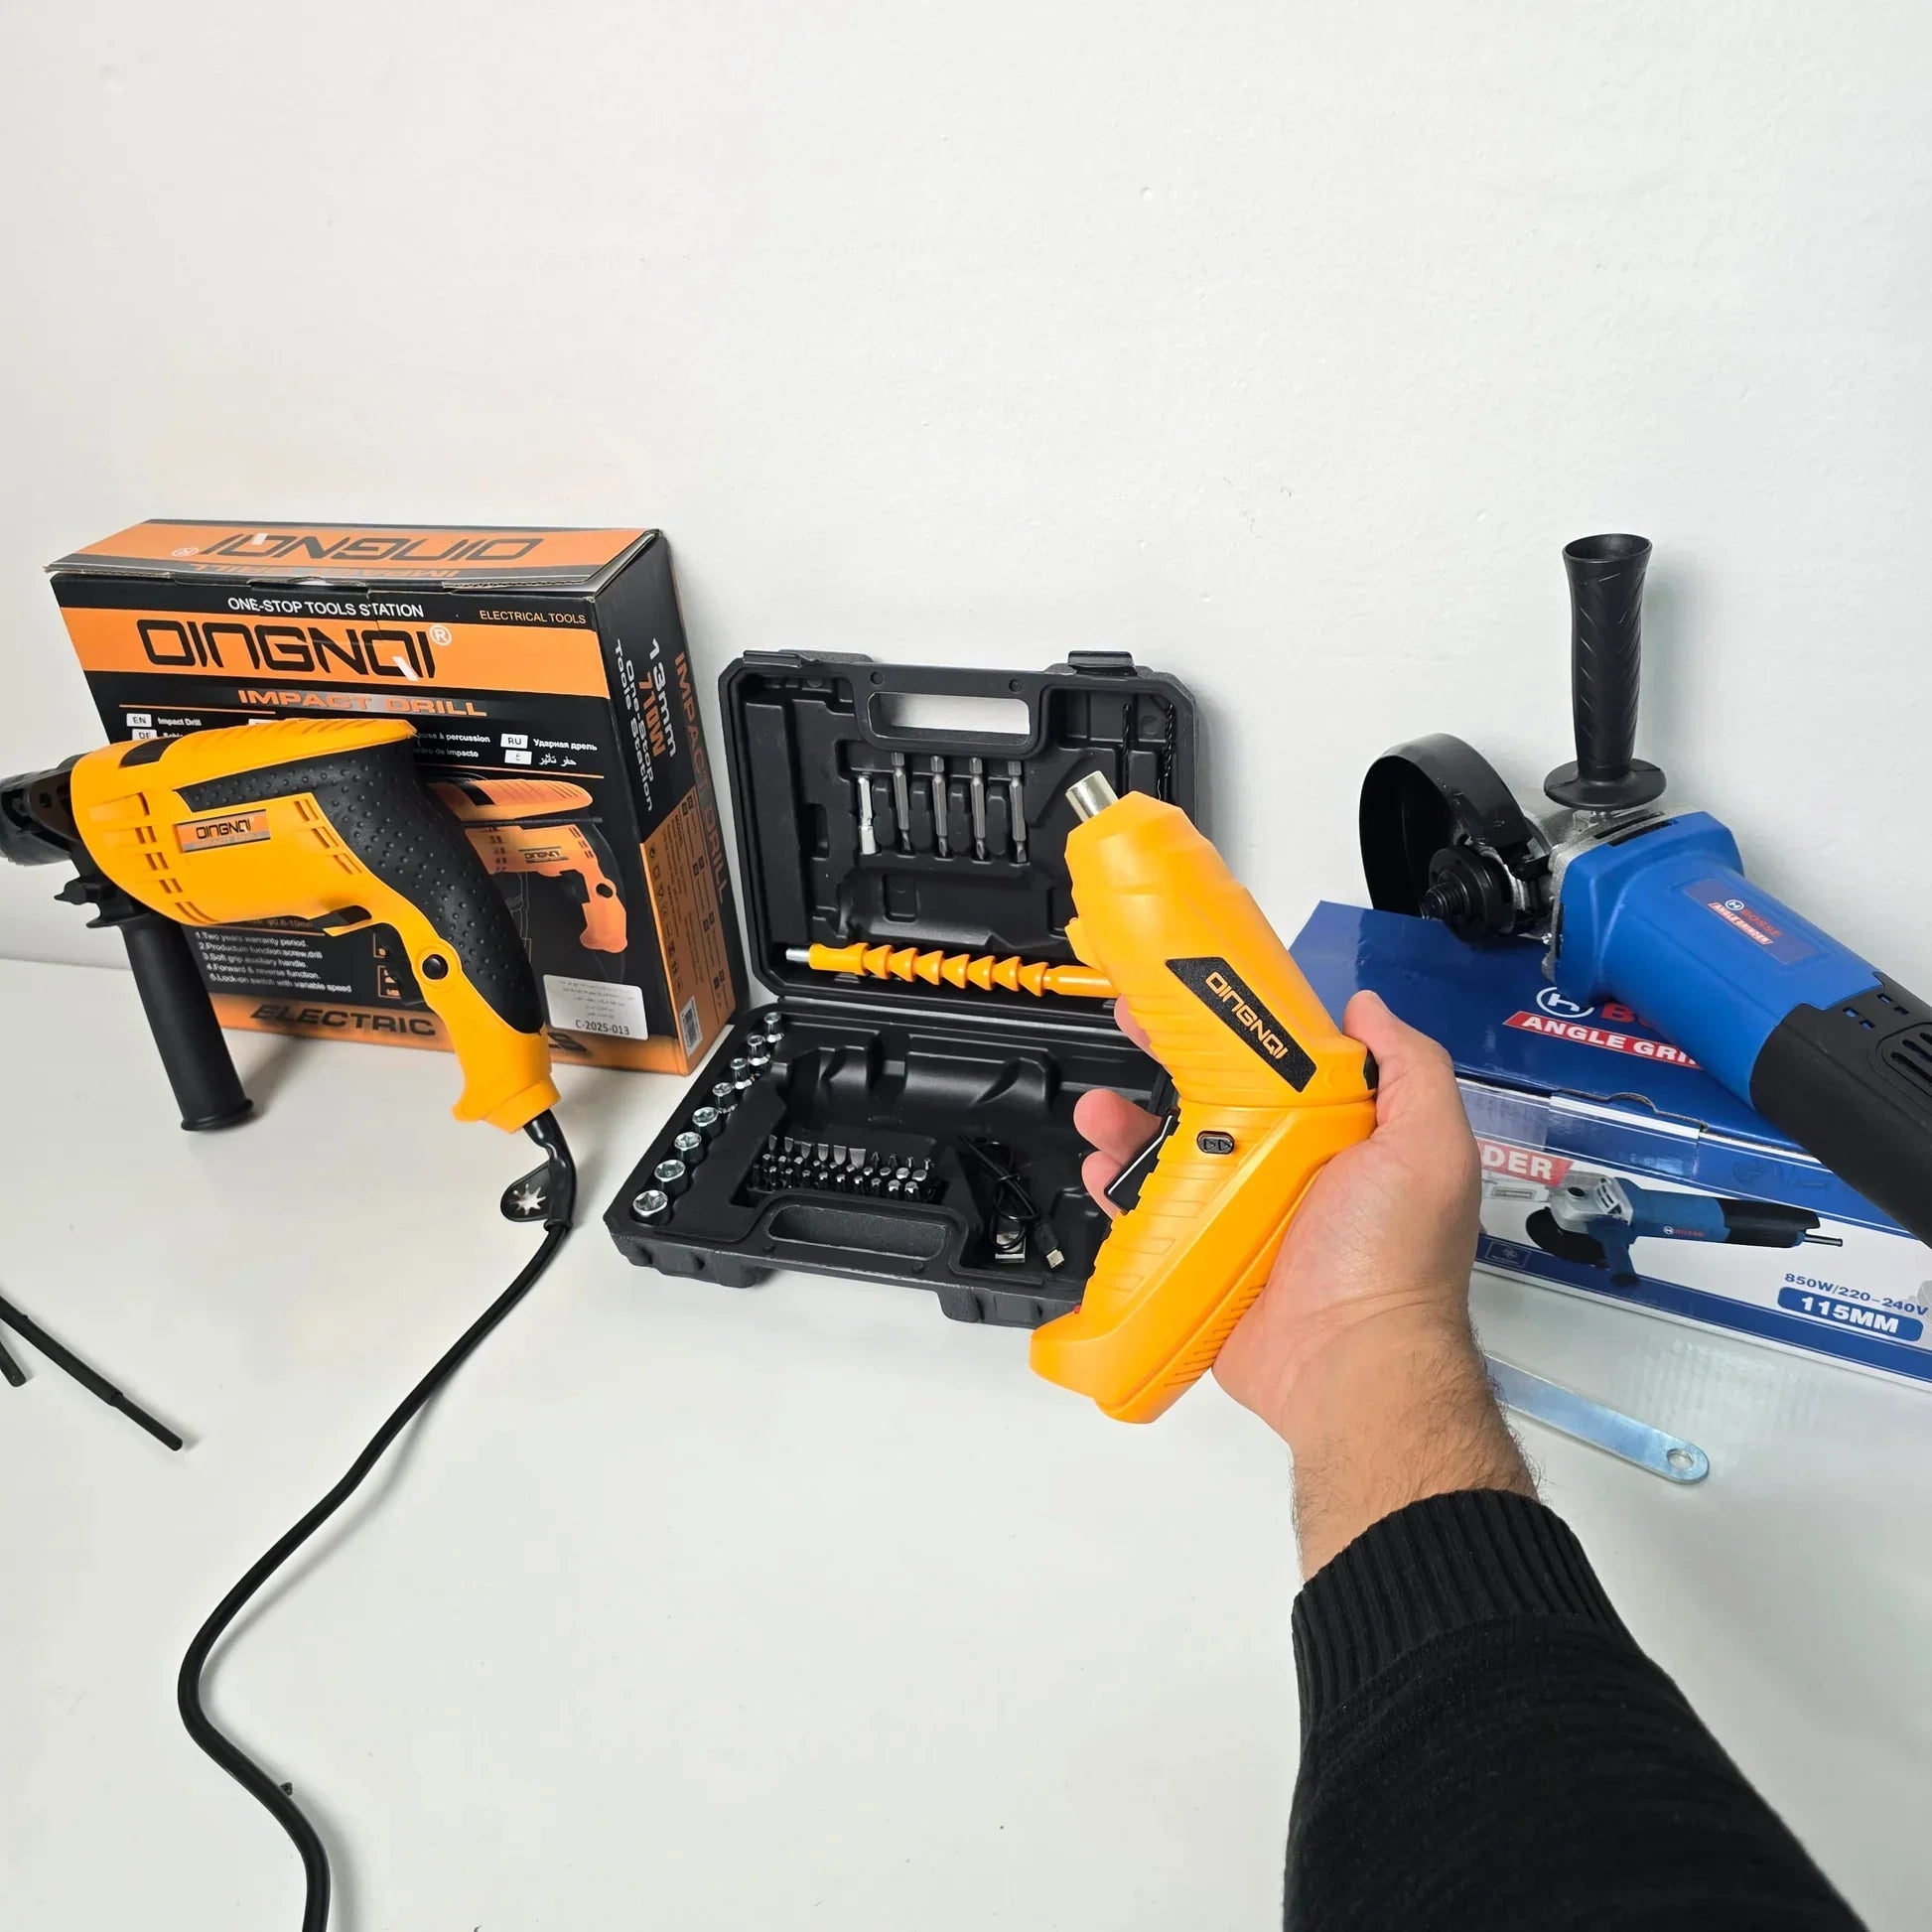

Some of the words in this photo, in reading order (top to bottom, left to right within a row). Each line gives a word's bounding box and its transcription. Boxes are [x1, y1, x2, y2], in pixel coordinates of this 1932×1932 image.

[227, 597, 302, 614] ONE-STOP
[305, 601, 356, 617] TOOLS
[358, 602, 424, 619] STATION
[480, 610, 547, 622] ELECTRICAL
[548, 612, 587, 624] TOOLS
[237, 689, 373, 711] IMPACT
[383, 697, 487, 717] DRILL
[637, 671, 666, 758] 710W
[132, 716, 147, 725] EN
[157, 717, 185, 727] Impact
[186, 717, 202, 726] Drill
[507, 737, 522, 746] RU
[675, 650, 709, 792] IMPACT
[704, 802, 728, 904] DRILL
[250, 1004, 437, 1036] ELECTRIC
[575, 1019, 630, 1035] C-2025-013
[1522, 1016, 1626, 1049] ANGLE
[1801, 1296, 1899, 1334] 115MM
